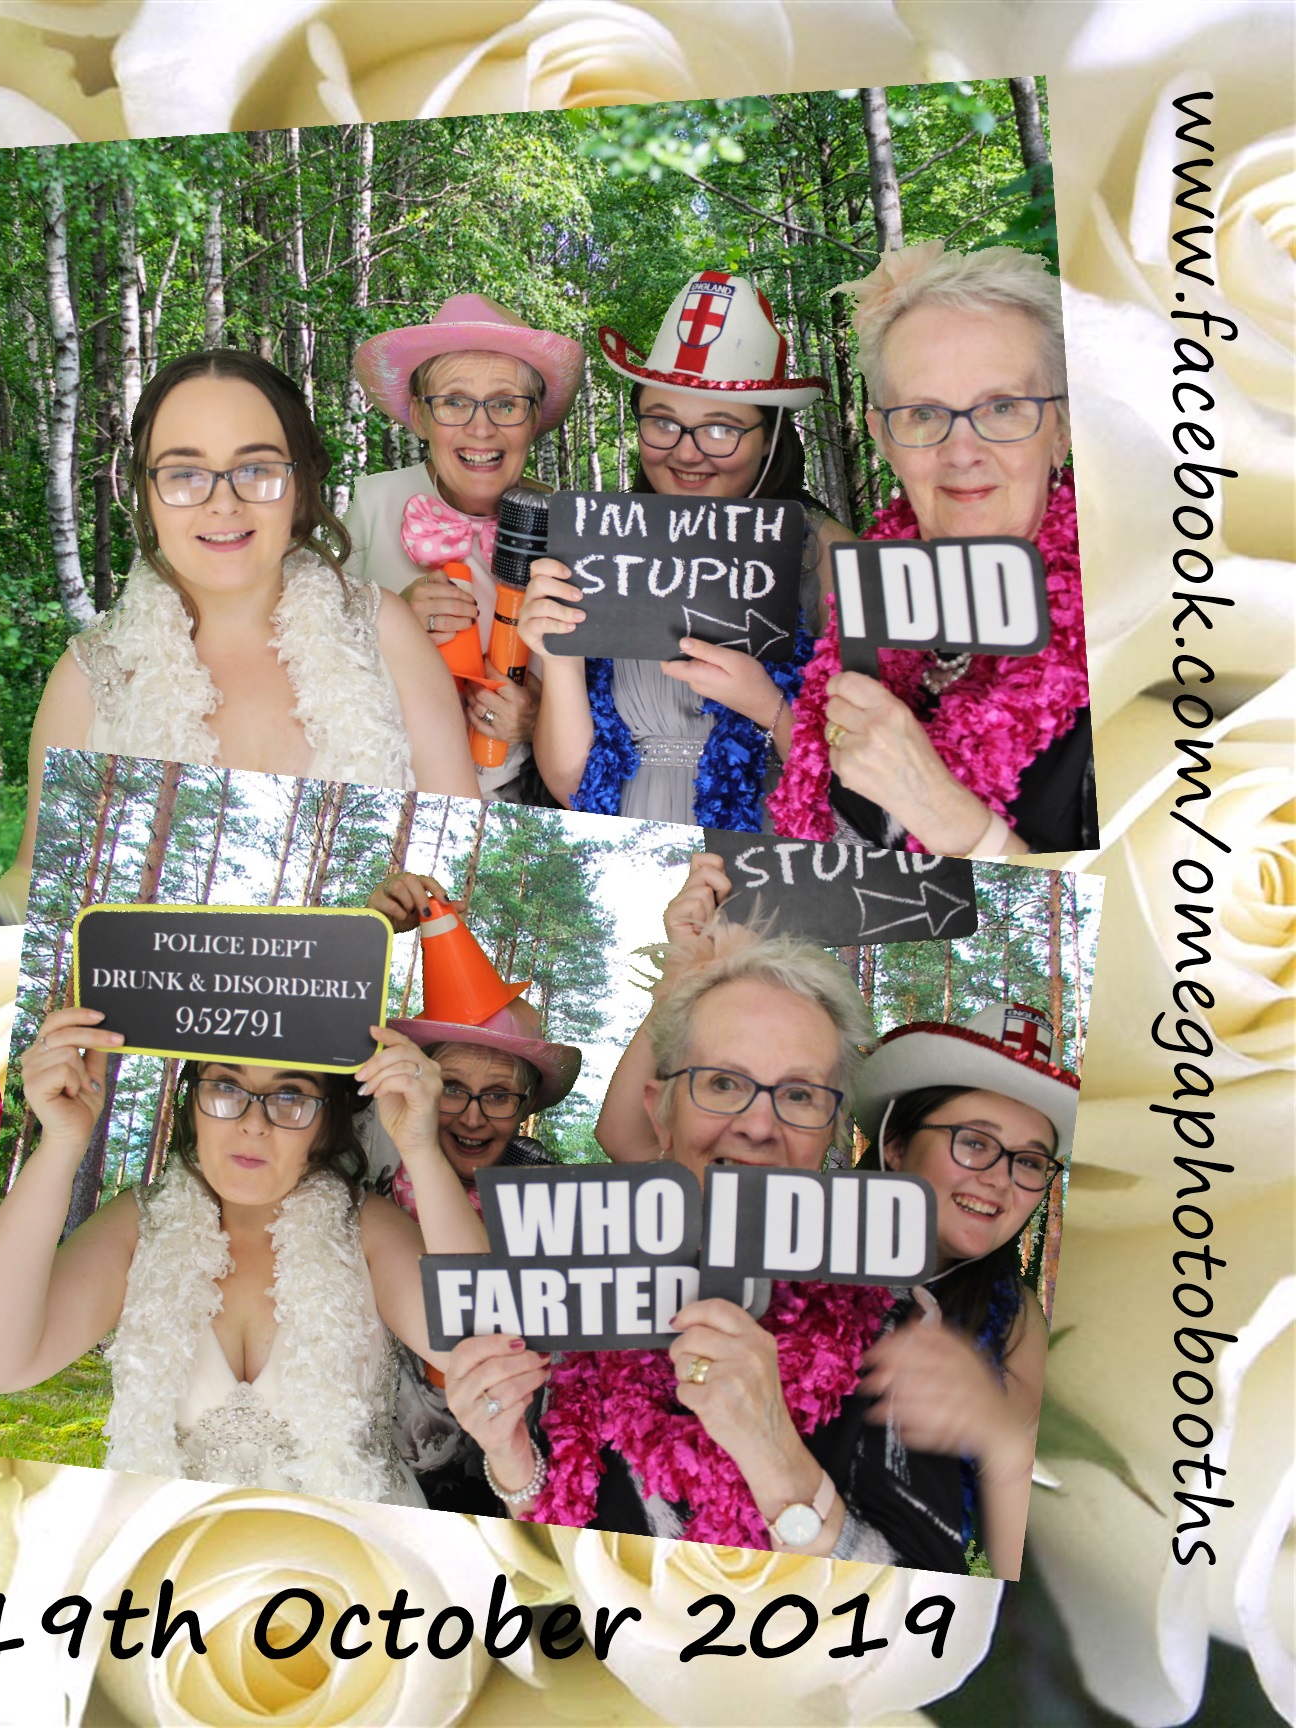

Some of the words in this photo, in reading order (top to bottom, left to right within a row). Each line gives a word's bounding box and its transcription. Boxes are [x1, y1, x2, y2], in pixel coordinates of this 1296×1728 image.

[691, 282, 733, 296] ENGLAND
[574, 496, 648, 538] I'M
[835, 548, 866, 639] I
[879, 543, 1039, 647] DID
[153, 931, 245, 957] POLICE
[251, 936, 318, 960] DEPT
[92, 967, 184, 992] DRUNK
[188, 972, 207, 992] &
[213, 973, 372, 1001] DISORDERLY
[174, 1005, 285, 1038] 952791
[495, 1177, 686, 1258] WHO
[707, 1171, 740, 1269] I
[762, 1173, 928, 1279] DID
